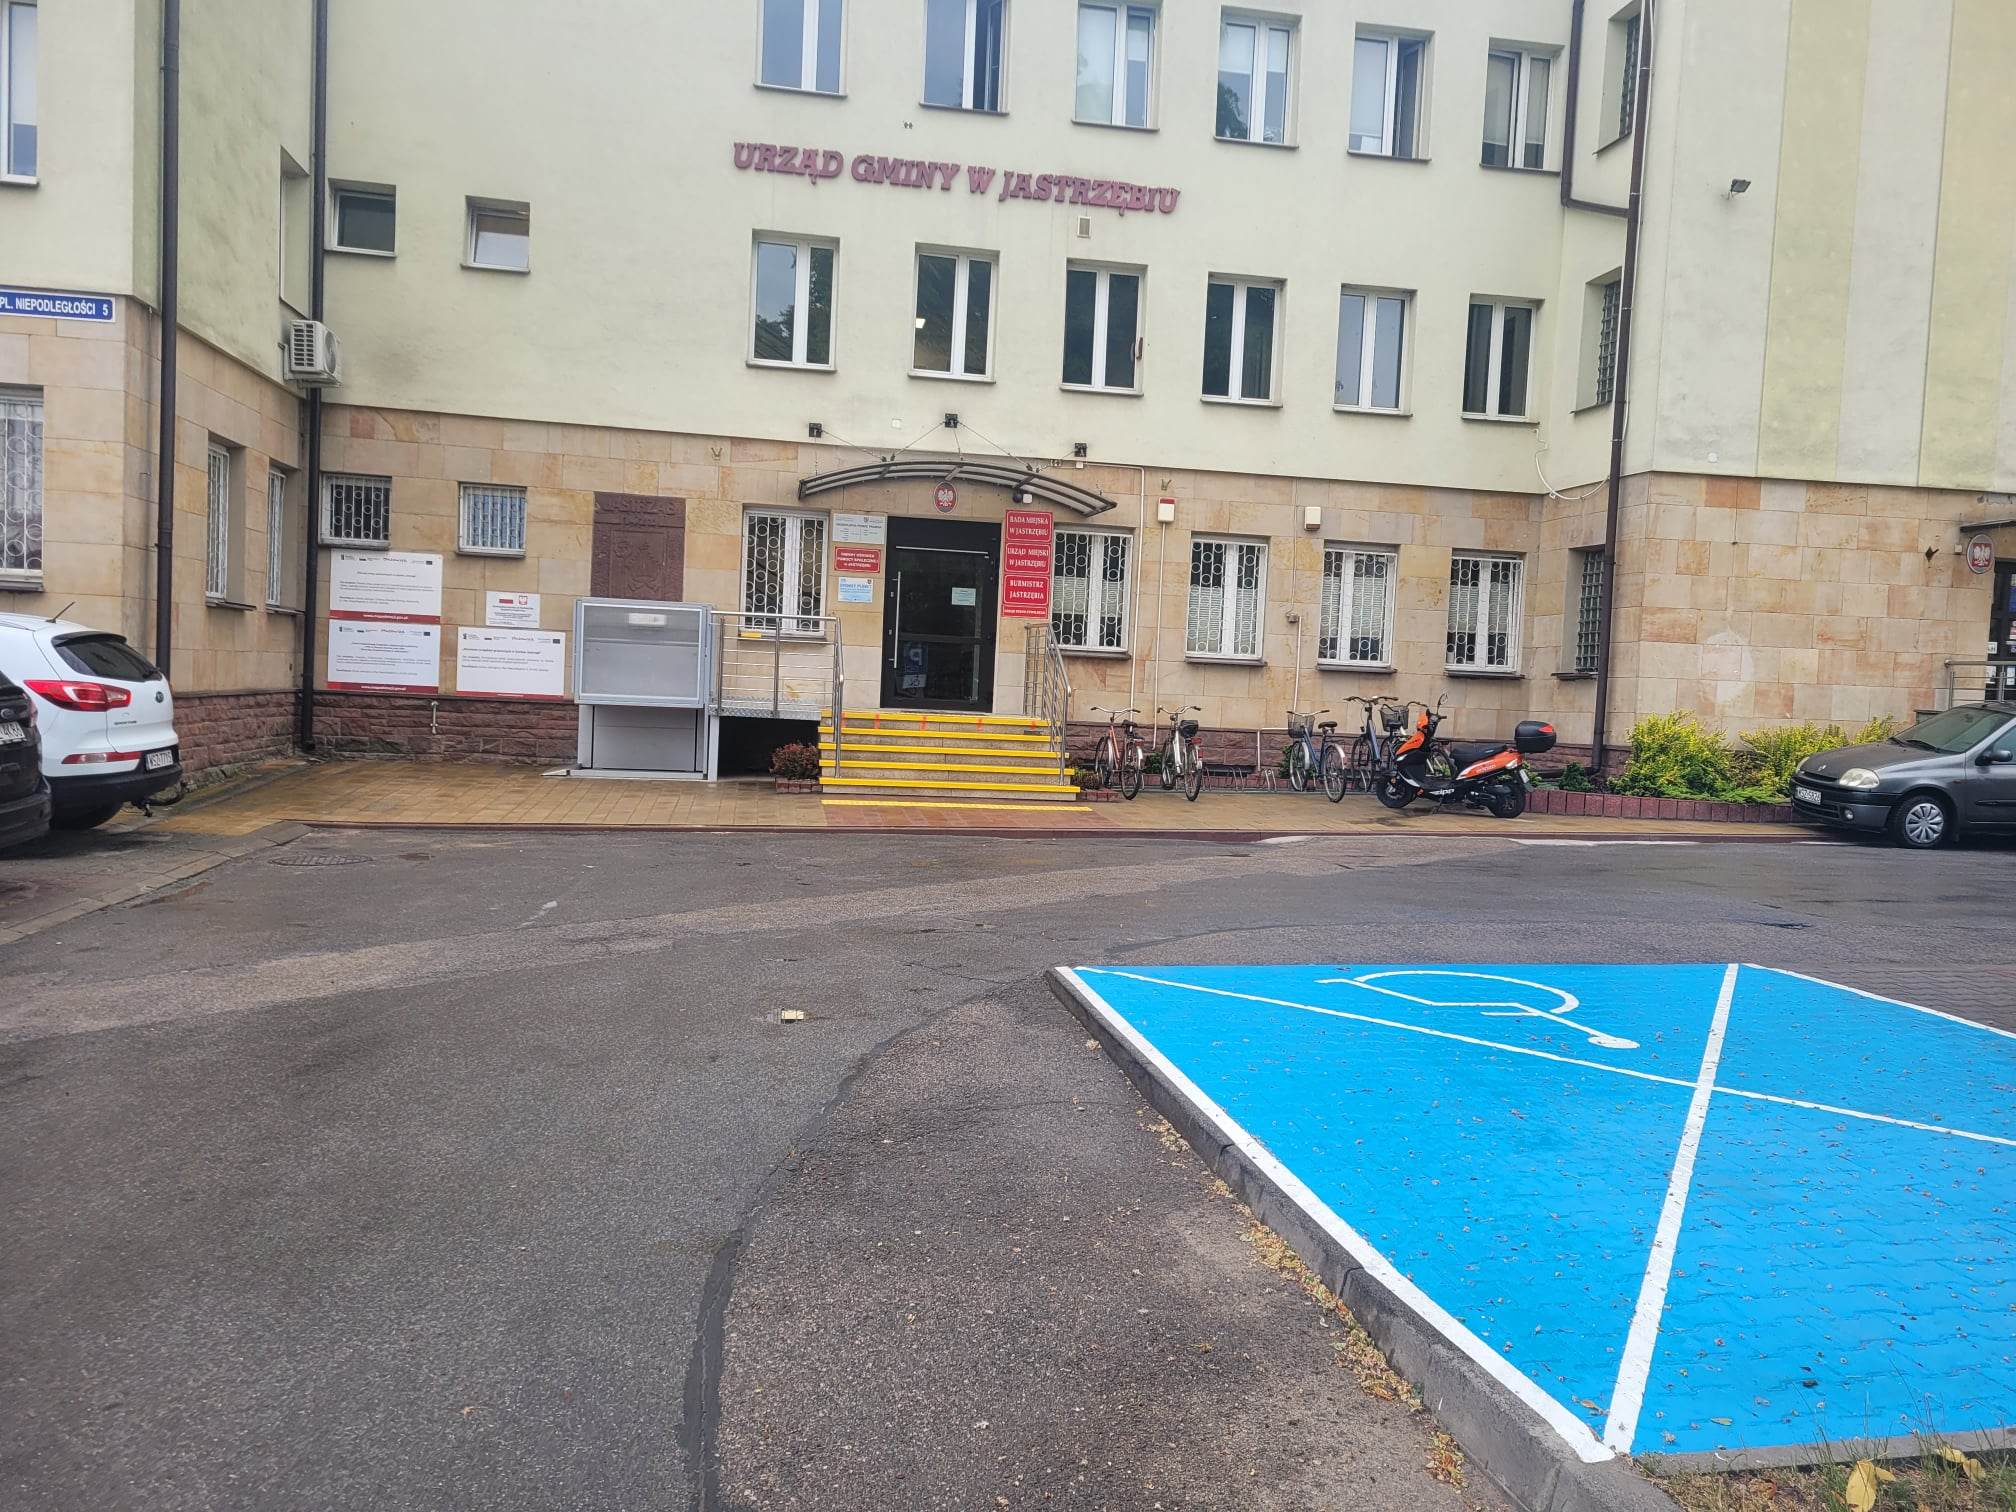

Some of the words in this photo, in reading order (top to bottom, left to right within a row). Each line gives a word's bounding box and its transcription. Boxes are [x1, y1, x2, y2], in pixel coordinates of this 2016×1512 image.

[734, 142, 844, 185] URZĄD
[850, 154, 960, 191] GMINY
[966, 165, 996, 195] W
[998, 170, 1181, 216] JASTRZĘBIU
[15, 297, 96, 315] NIEPODLEGŁOŚCI
[102, 304, 109, 316] 5
[1009, 579, 1044, 589] BURMISTRZ
